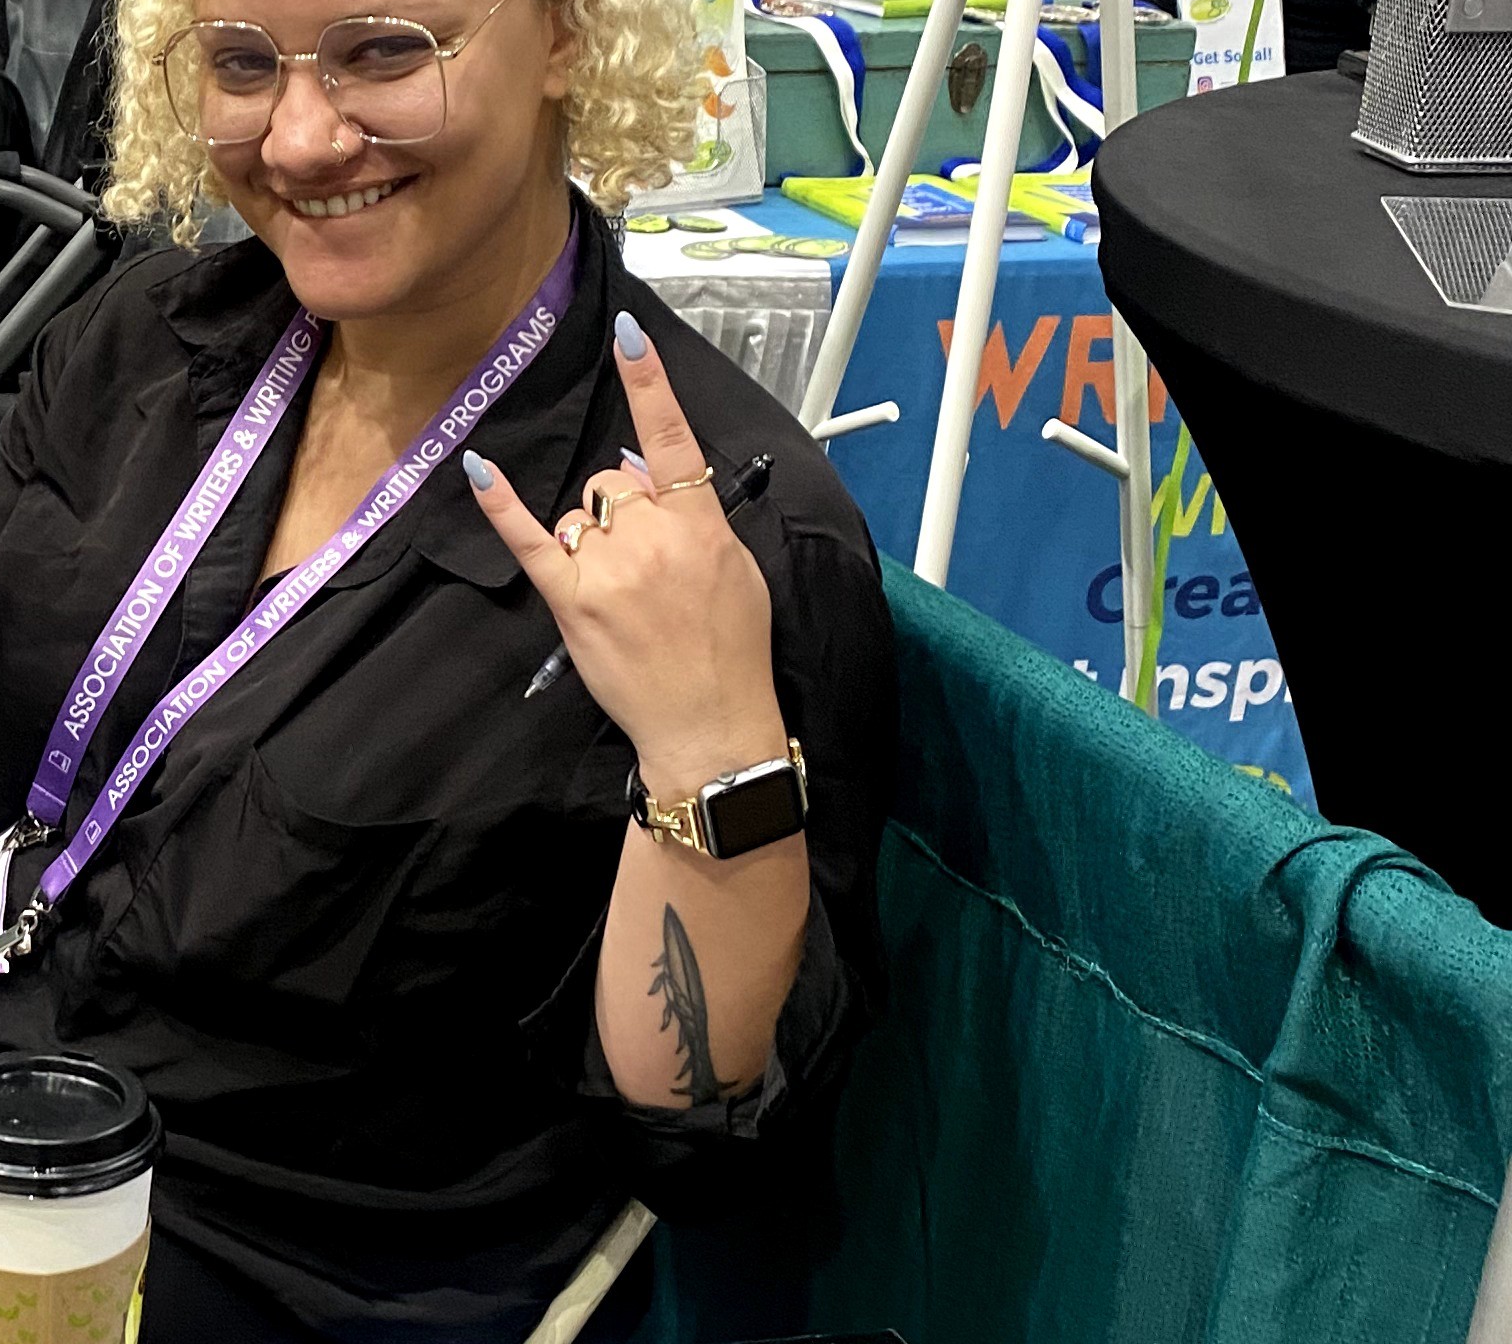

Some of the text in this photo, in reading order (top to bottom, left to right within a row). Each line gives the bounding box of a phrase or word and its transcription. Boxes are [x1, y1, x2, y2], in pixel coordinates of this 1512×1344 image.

[1193, 51, 1219, 65] Get
[62, 331, 312, 743] ASSOCIATION OF WRITERS & WRITING
[107, 305, 559, 812] ASSOCIATION OF WRITERS & WRITING PROGRAMS
